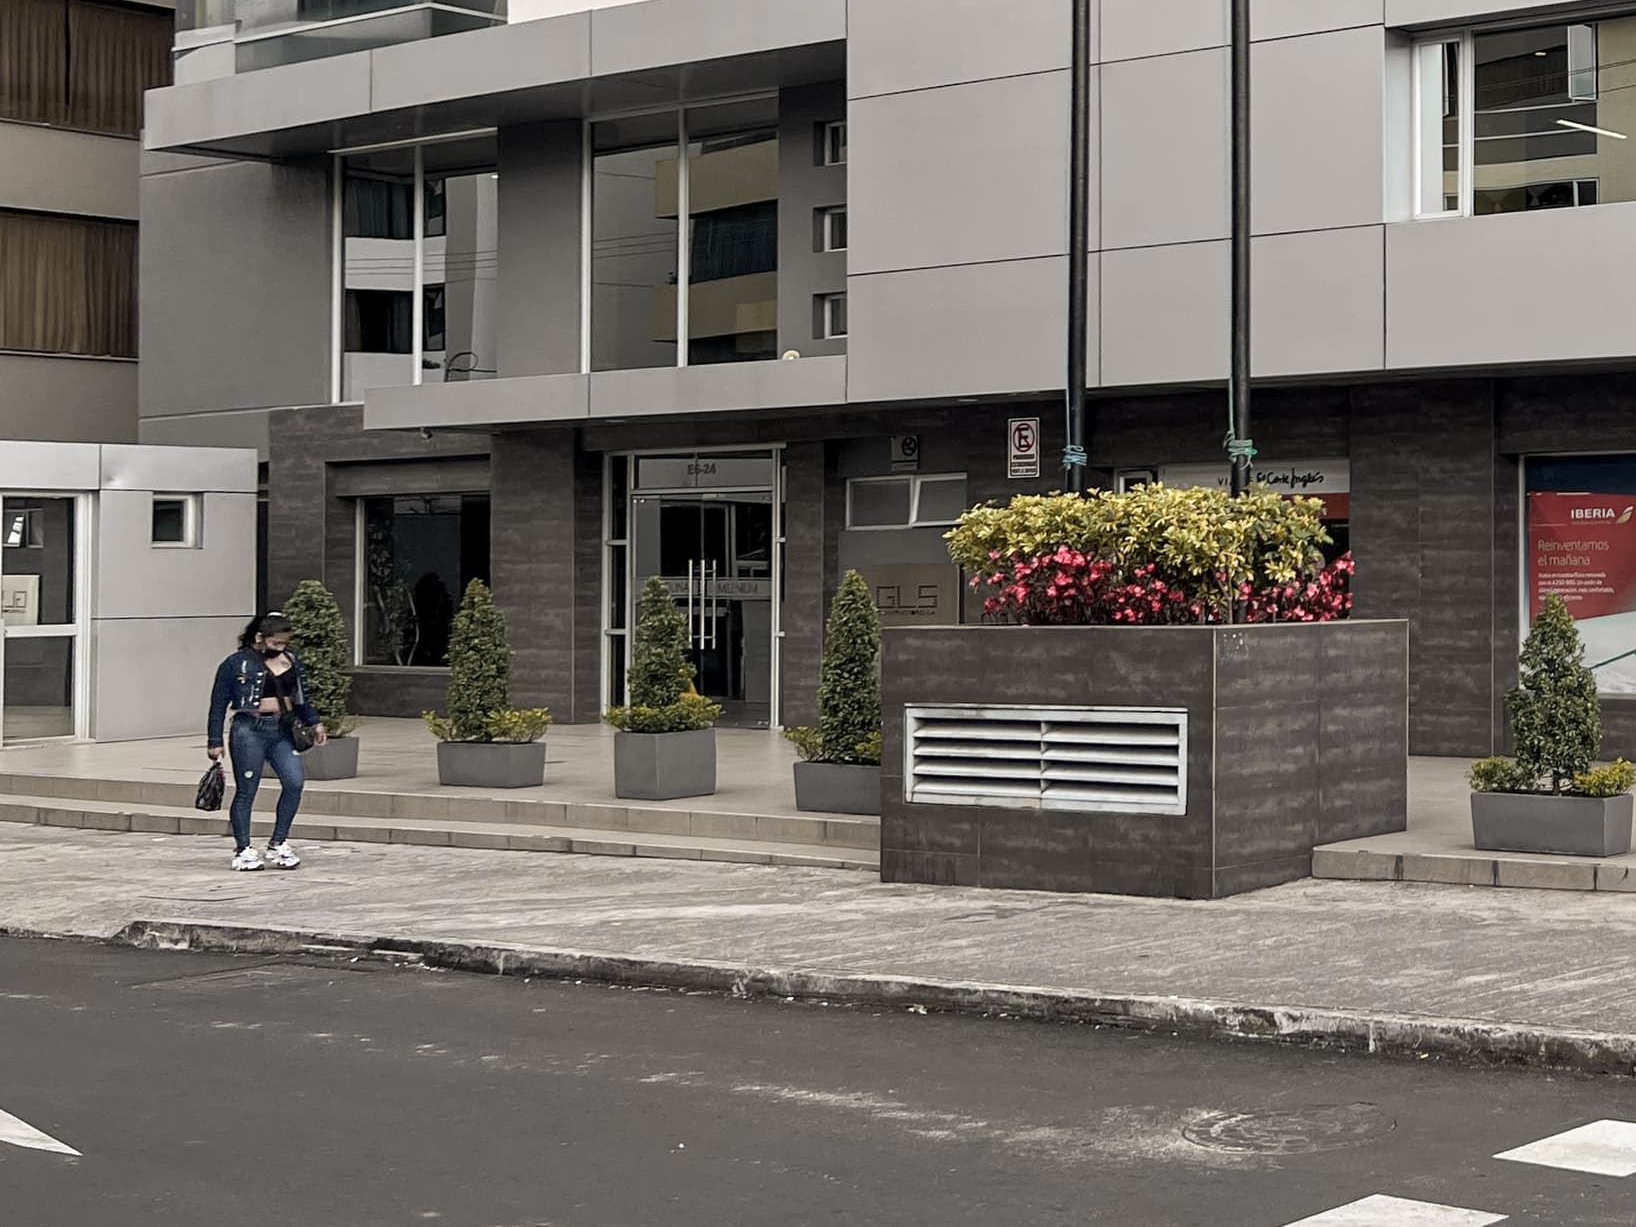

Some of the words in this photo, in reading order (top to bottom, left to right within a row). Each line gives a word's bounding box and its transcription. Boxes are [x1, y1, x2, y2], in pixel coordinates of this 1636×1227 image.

[1571, 508, 1616, 519] IBERIA
[1537, 539, 1610, 551] Reinventamos
[1538, 555, 1547, 566] el
[1549, 554, 1591, 566] mañana
[876, 585, 938, 609] GLS
